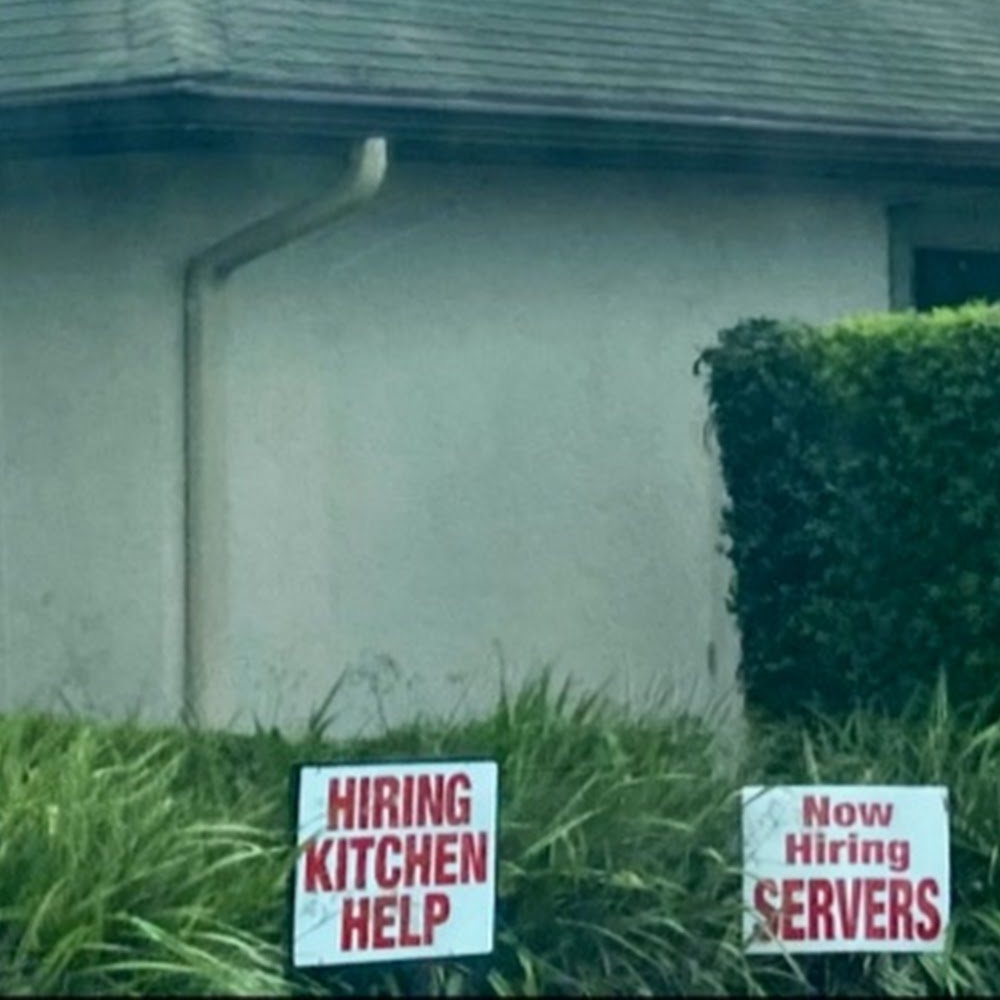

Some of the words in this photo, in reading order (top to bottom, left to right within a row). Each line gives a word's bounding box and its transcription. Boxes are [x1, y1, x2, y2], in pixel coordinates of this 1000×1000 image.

[326, 772, 472, 831] HIRING
[802, 795, 894, 828] Now
[303, 831, 488, 893] KITCHEN
[785, 833, 911, 872] Hiring
[340, 893, 451, 952] HELP
[753, 877, 942, 942] SERVERS
